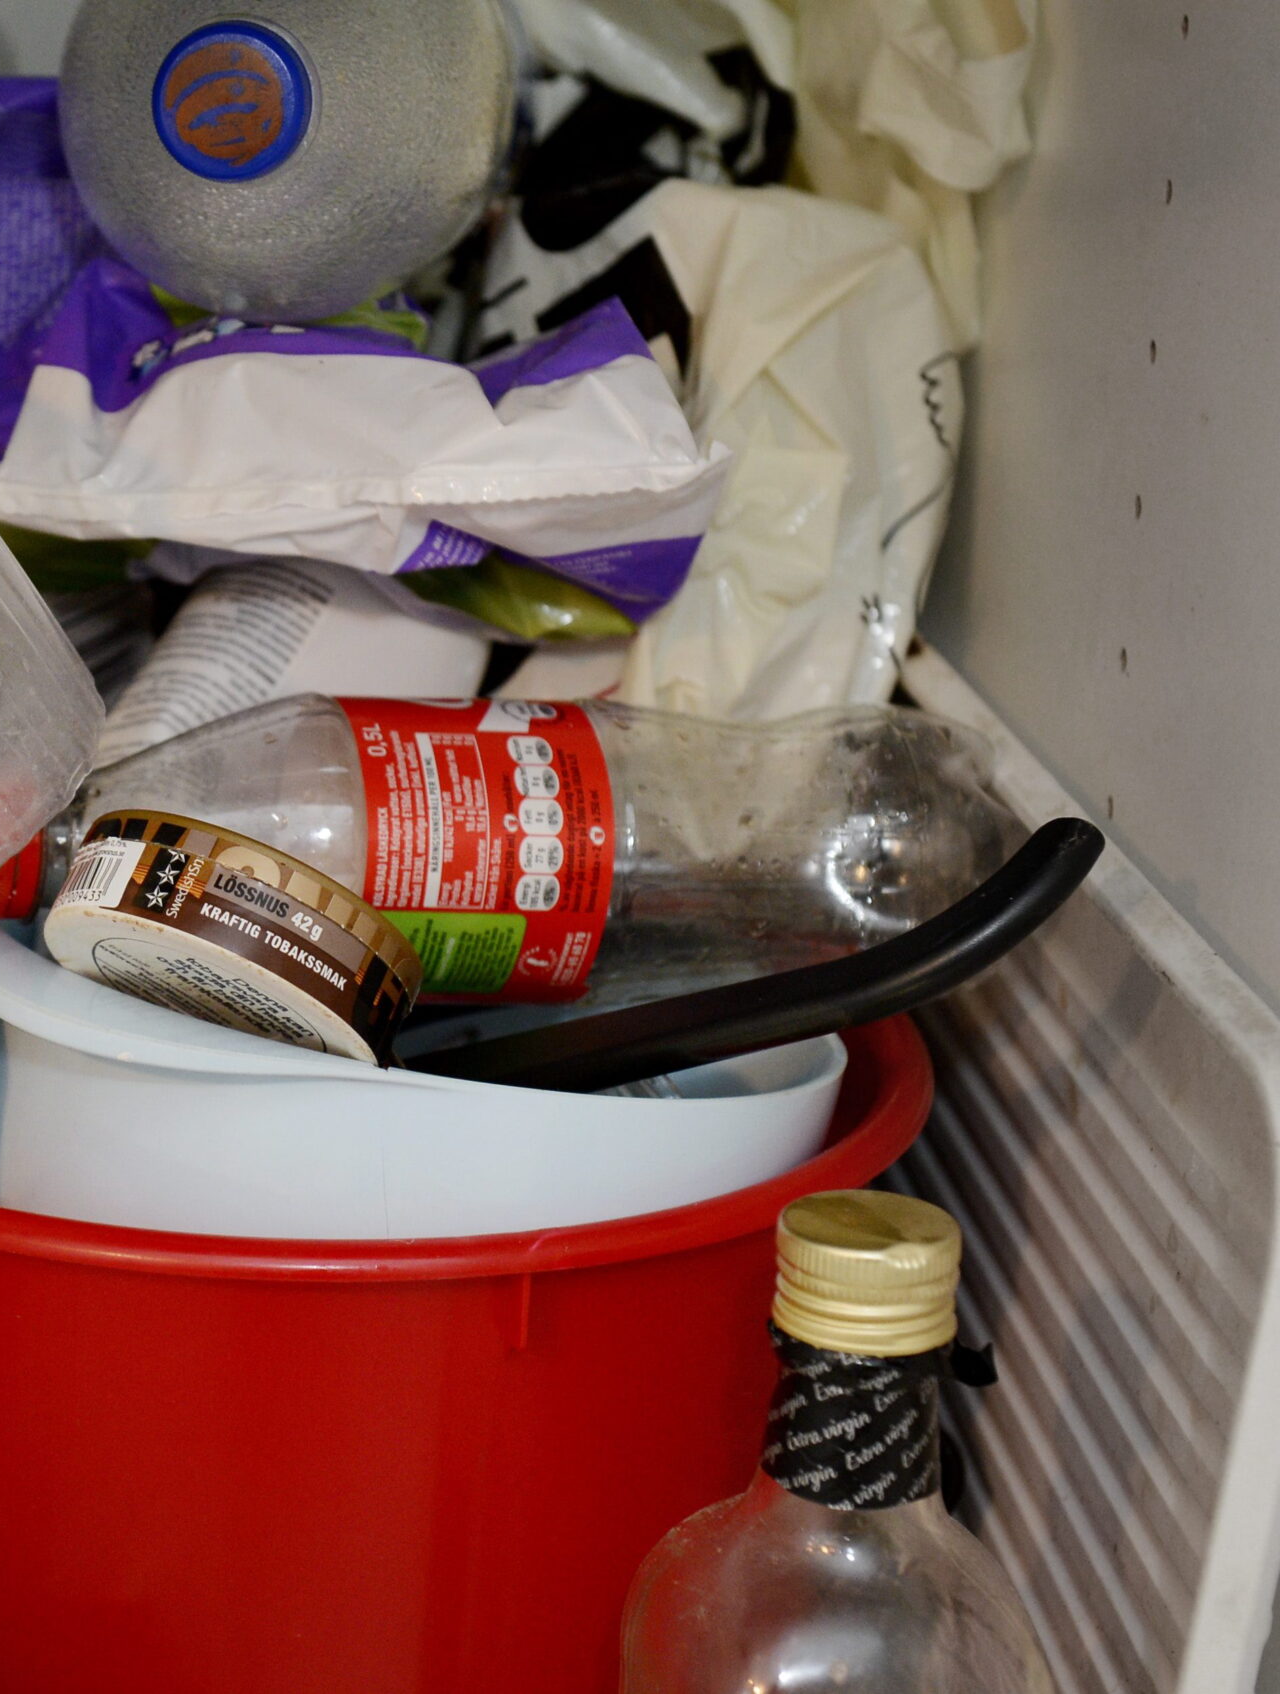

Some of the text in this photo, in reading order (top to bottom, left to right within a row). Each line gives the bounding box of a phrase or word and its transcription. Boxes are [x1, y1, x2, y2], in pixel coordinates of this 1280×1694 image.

[362, 723, 387, 756] 0,5L
[427, 781, 435, 795] PER
[428, 798, 441, 872] NÄRINGSINNEHÅLL
[373, 806, 388, 906] KOLSYRAD LÄSKEDRYCK
[214, 873, 290, 919] LÖSSNUS
[200, 902, 261, 939] KRAFTIG
[265, 930, 348, 992] TOBAKSSMAK
[823, 1411, 872, 1441] virgin
[845, 1408, 919, 1471] Extra virgin
[792, 1464, 838, 1493] virgin
[853, 1471, 898, 1505] virgin
